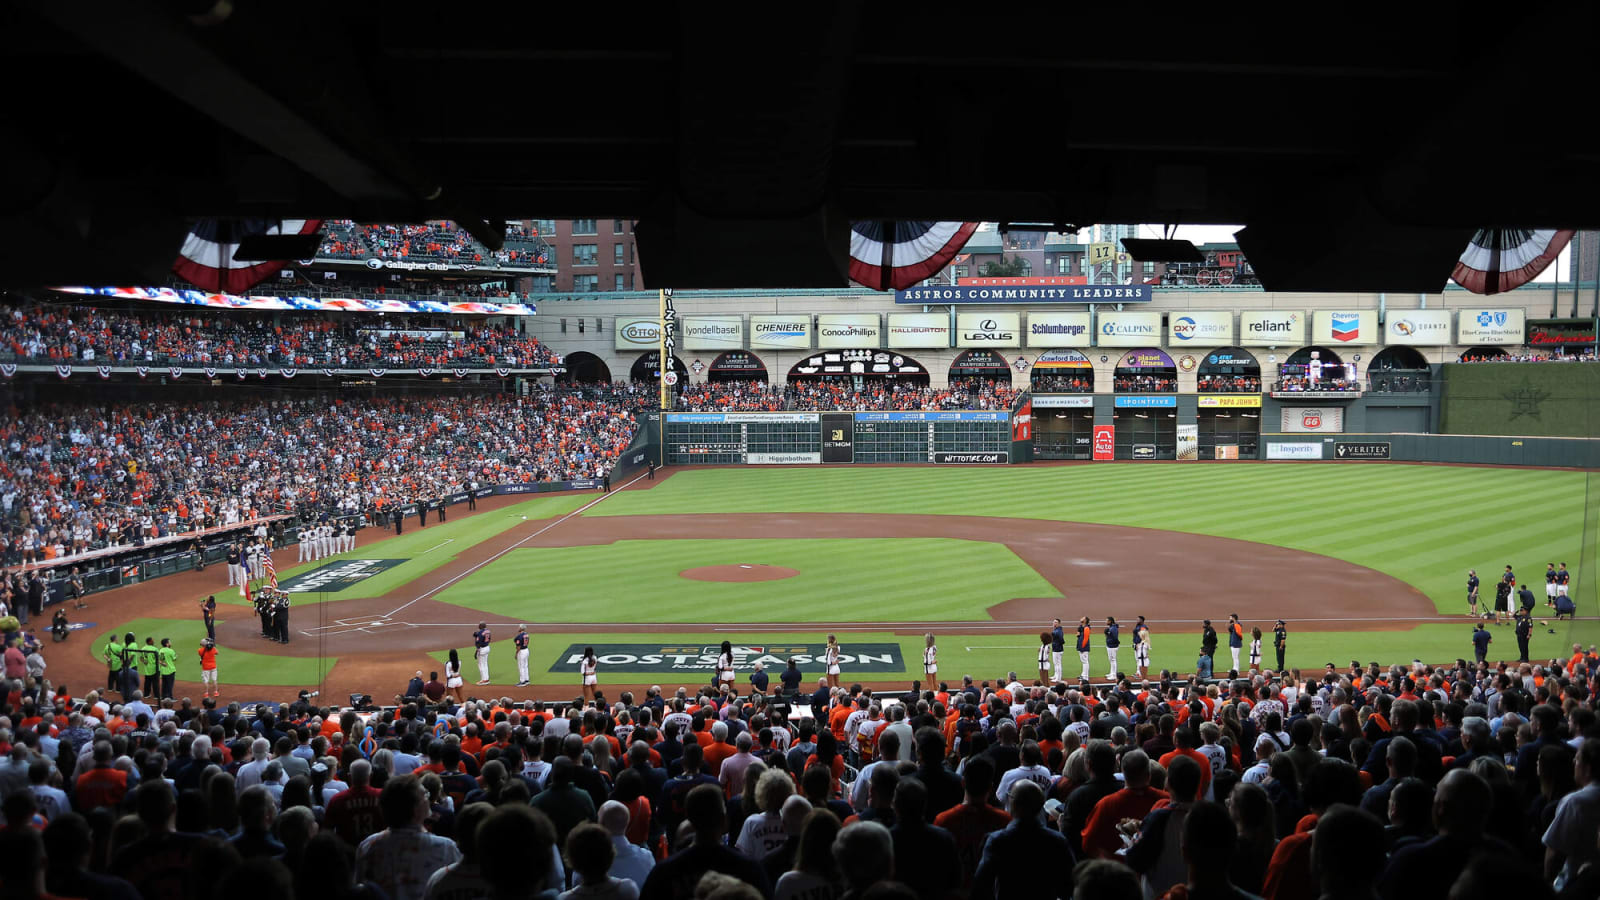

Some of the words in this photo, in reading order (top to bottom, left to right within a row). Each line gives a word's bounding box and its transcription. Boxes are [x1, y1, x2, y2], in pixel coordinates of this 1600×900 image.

[1095, 246, 1110, 258] 17
[385, 261, 426, 271] Gallagher
[427, 262, 449, 271] Club
[903, 289, 961, 300] ASTROS
[968, 289, 1066, 299] COMMUNITY
[1073, 288, 1143, 299] LEADERS
[685, 325, 740, 336] lyondellbasell
[755, 323, 806, 332] CHENIERE
[1031, 323, 1086, 336] Schlumberger
[1116, 324, 1154, 333] CALPINE
[1249, 320, 1291, 332] reliant
[821, 327, 877, 338] ConocoPhillips
[964, 333, 1013, 341] LEXUS
[1137, 354, 1161, 362] planet
[1219, 398, 1235, 406] PAPA
[1235, 398, 1258, 406] JOHN'S
[1304, 417, 1319, 426] 66
[1279, 445, 1313, 453] Insperity
[944, 454, 999, 463] NITTOTIRE.COM
[351, 812, 374, 834] 13
